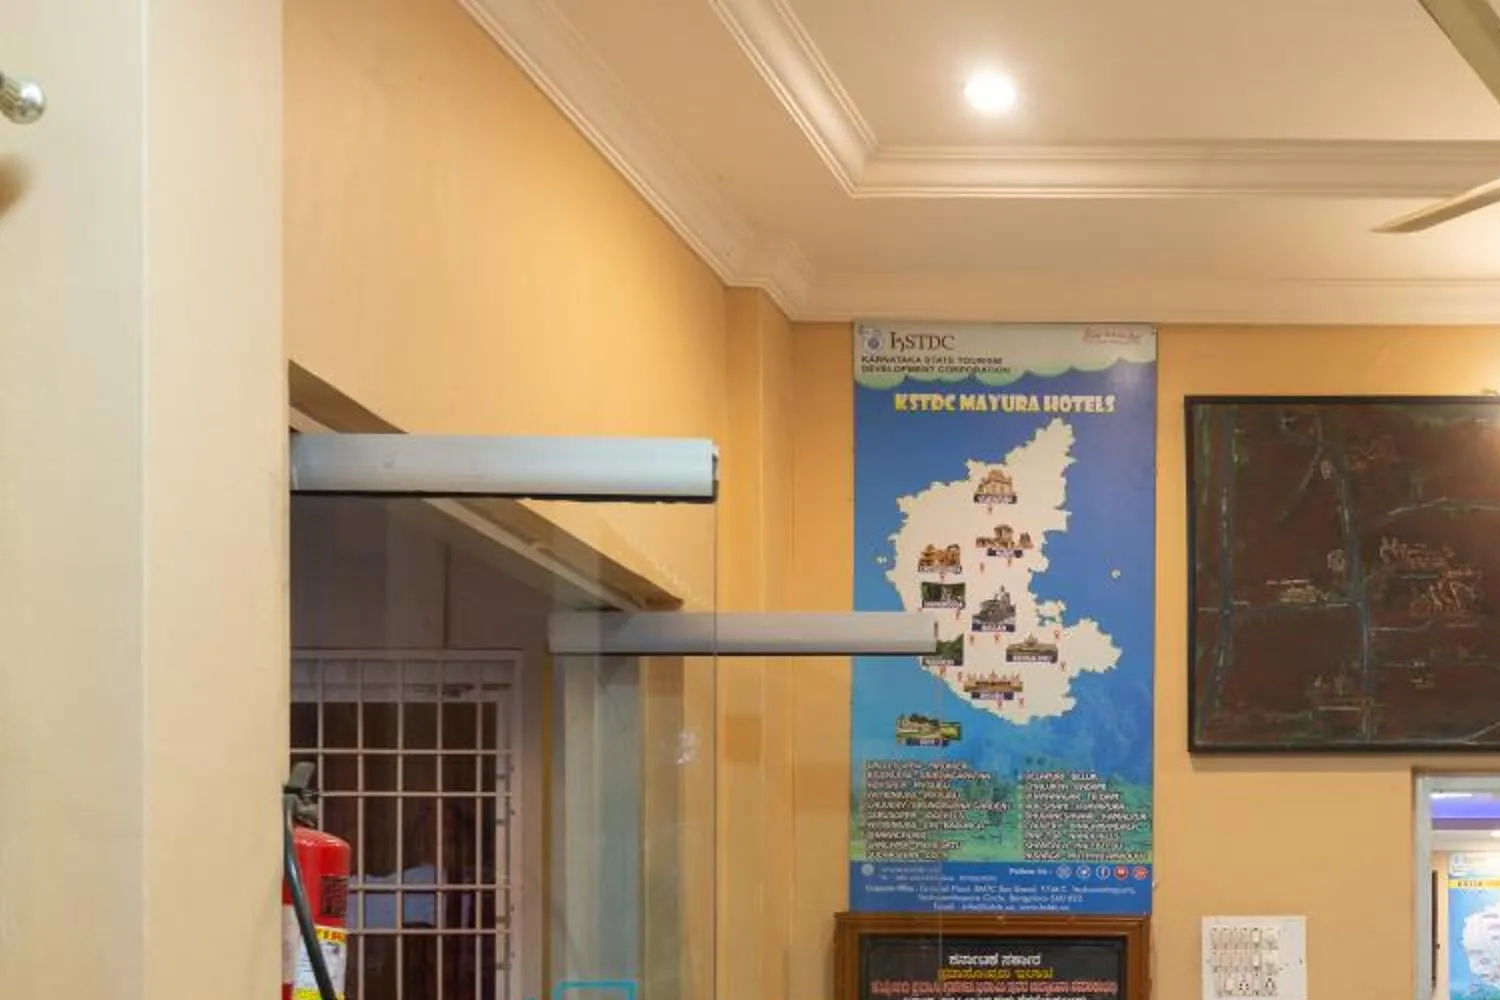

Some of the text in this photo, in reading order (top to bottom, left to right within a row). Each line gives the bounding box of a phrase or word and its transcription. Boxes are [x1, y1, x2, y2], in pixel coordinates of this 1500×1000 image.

[895, 393, 1116, 413] KSTDC MAYURA HOTELS
